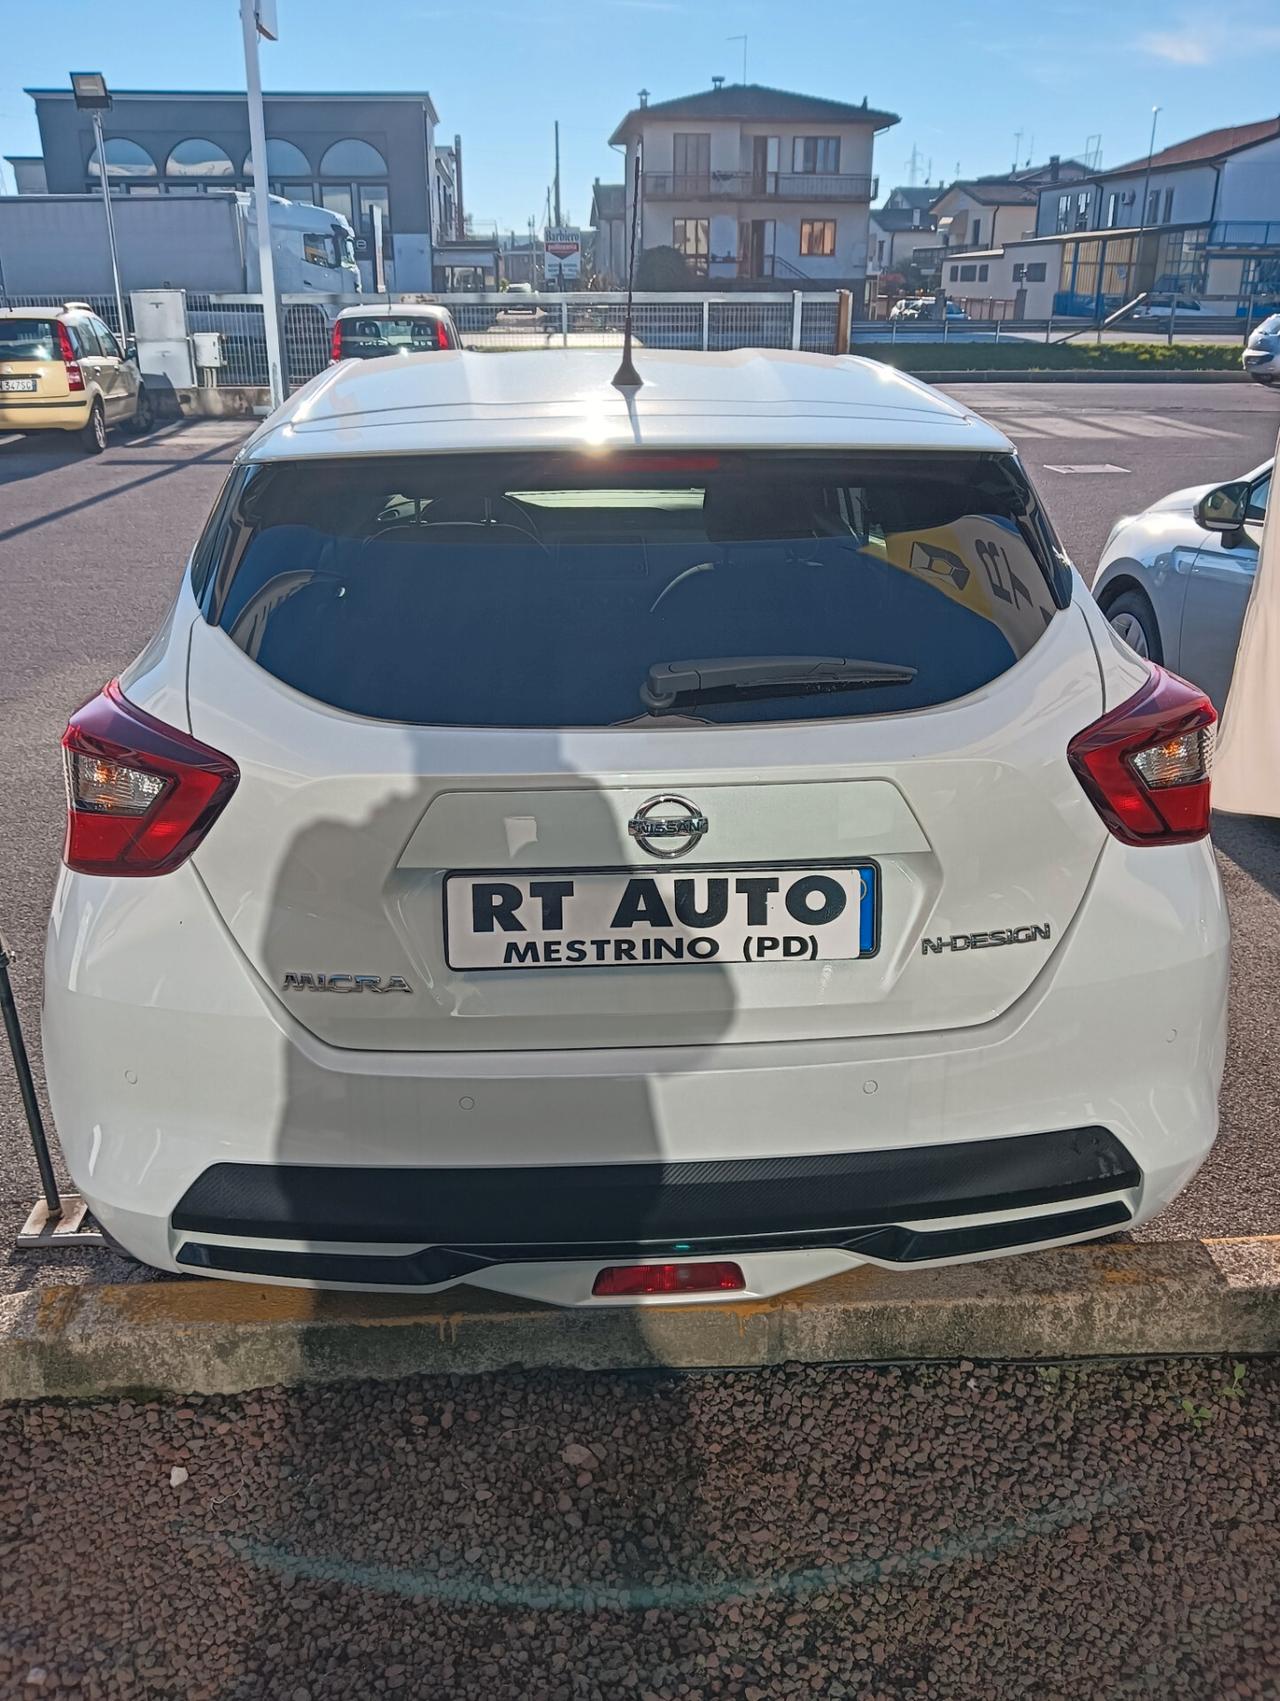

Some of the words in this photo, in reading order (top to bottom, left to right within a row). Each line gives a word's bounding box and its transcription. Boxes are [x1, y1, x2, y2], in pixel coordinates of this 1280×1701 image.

[637, 820, 701, 834] NISSAN
[472, 881, 574, 932] RT
[609, 875, 847, 929] AUTO
[503, 936, 720, 963] MESTRINO
[743, 935, 819, 962] (PD)
[921, 922, 1051, 955] N-DESIGN
[281, 971, 414, 994] MICRA
